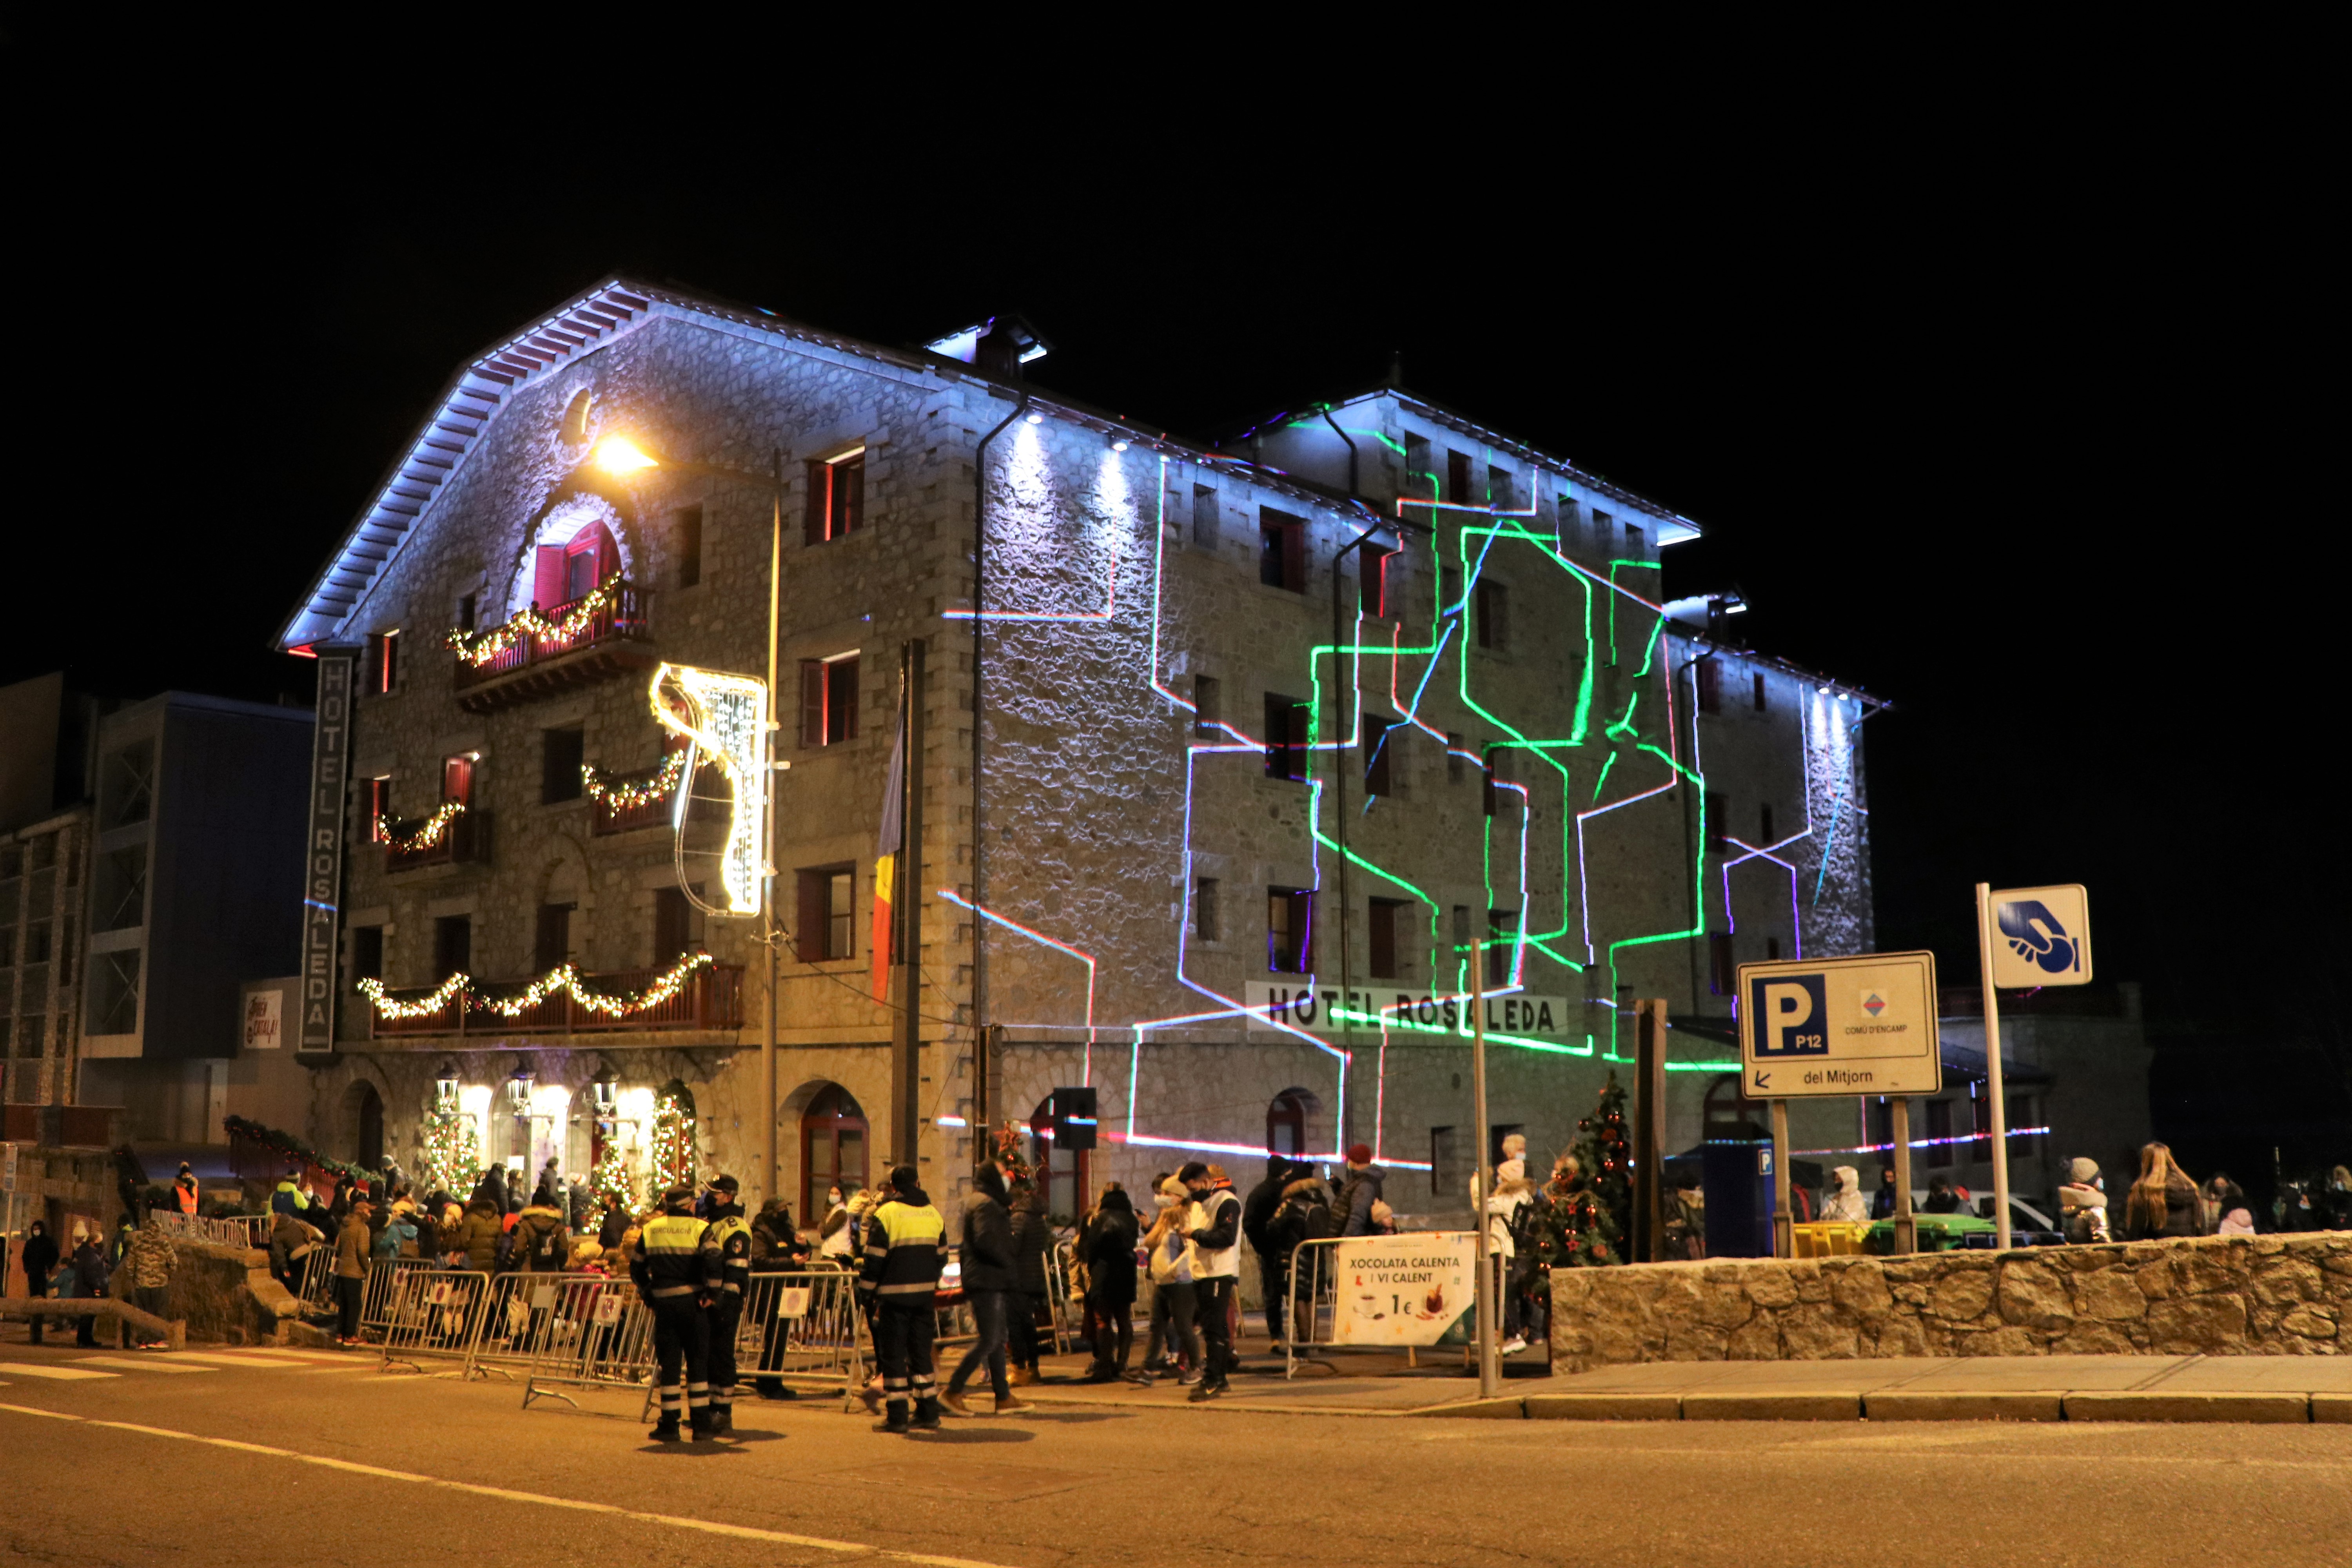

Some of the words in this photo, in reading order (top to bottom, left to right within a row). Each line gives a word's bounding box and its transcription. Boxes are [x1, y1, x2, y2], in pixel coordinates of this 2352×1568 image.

[319, 665, 344, 814] HOTEL
[309, 829, 334, 1024] ROSALEDA
[1269, 987, 1380, 1028] HOTEL
[1765, 982, 1813, 1050] P
[1795, 1034, 1822, 1049] P12
[1804, 1071, 1822, 1084] del
[1827, 1069, 1873, 1086] Mitjorn
[1762, 1153, 1770, 1171] P
[1350, 1258, 1408, 1269] XOCOLATA
[1411, 1257, 1460, 1268] CALENTA
[1378, 1274, 1389, 1283] VI
[1392, 1272, 1432, 1283] CALENT
[1392, 1294, 1399, 1314] 1
